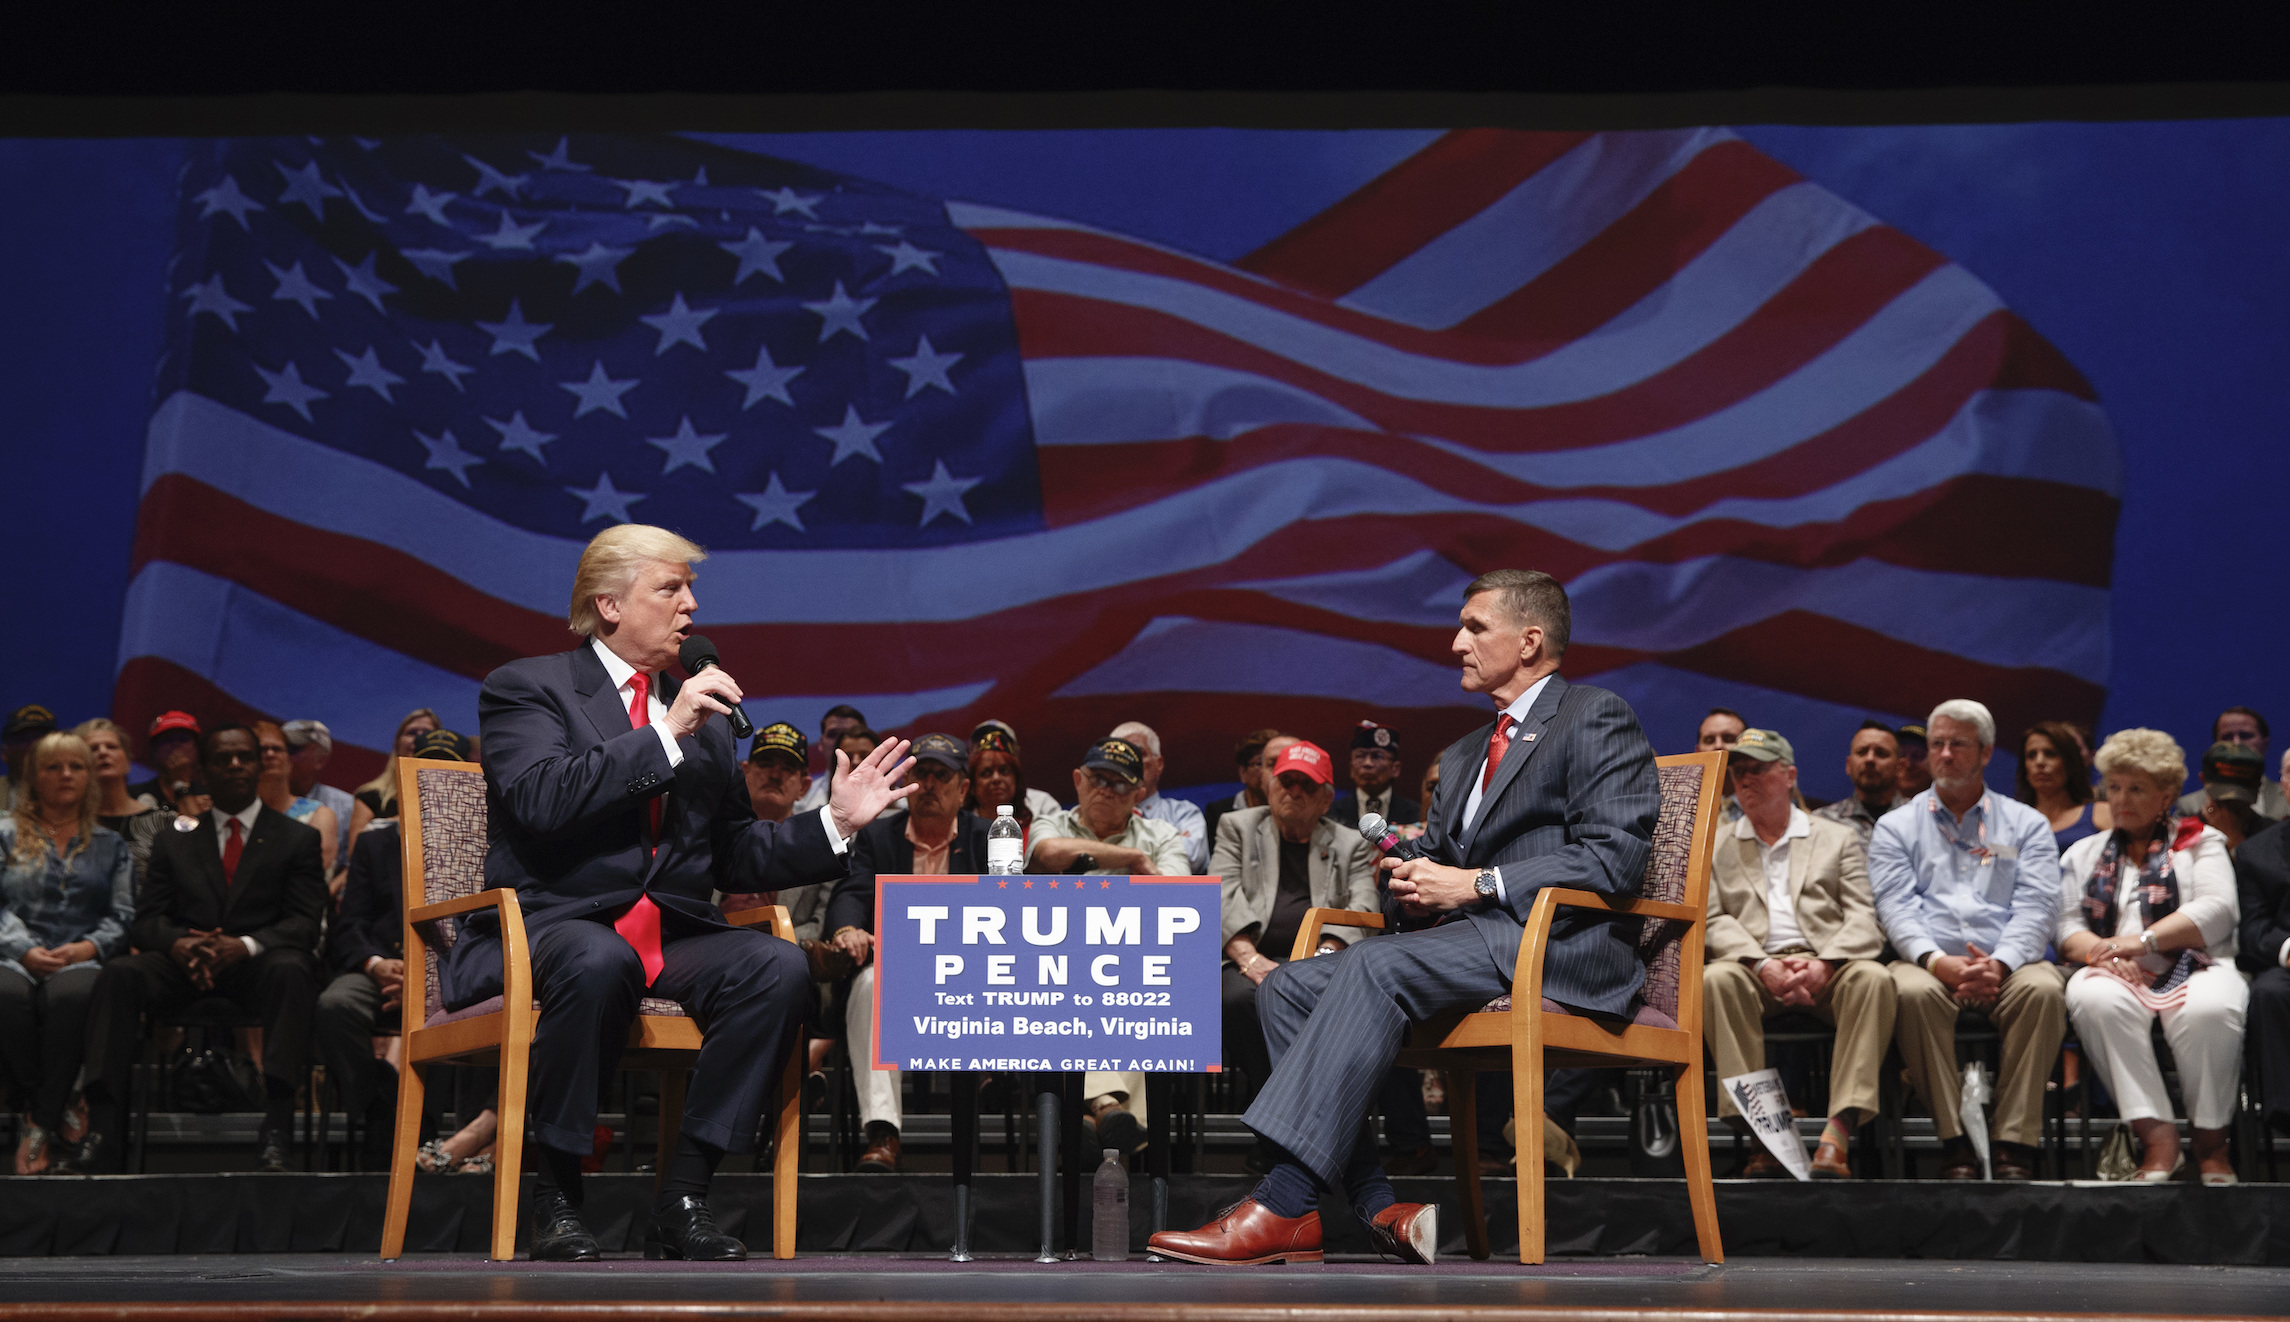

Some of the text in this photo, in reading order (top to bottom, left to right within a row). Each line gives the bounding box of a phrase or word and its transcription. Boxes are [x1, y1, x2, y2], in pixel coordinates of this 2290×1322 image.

[906, 905, 1201, 946] TRUMP
[934, 953, 1172, 986] PENCE
[934, 991, 1171, 1007] Text TRUMP to 88022
[913, 1016, 1193, 1041] Virginia Beach, Virginia
[909, 1057, 1196, 1072] MAKE AMERICA GREAT AGAIN!
